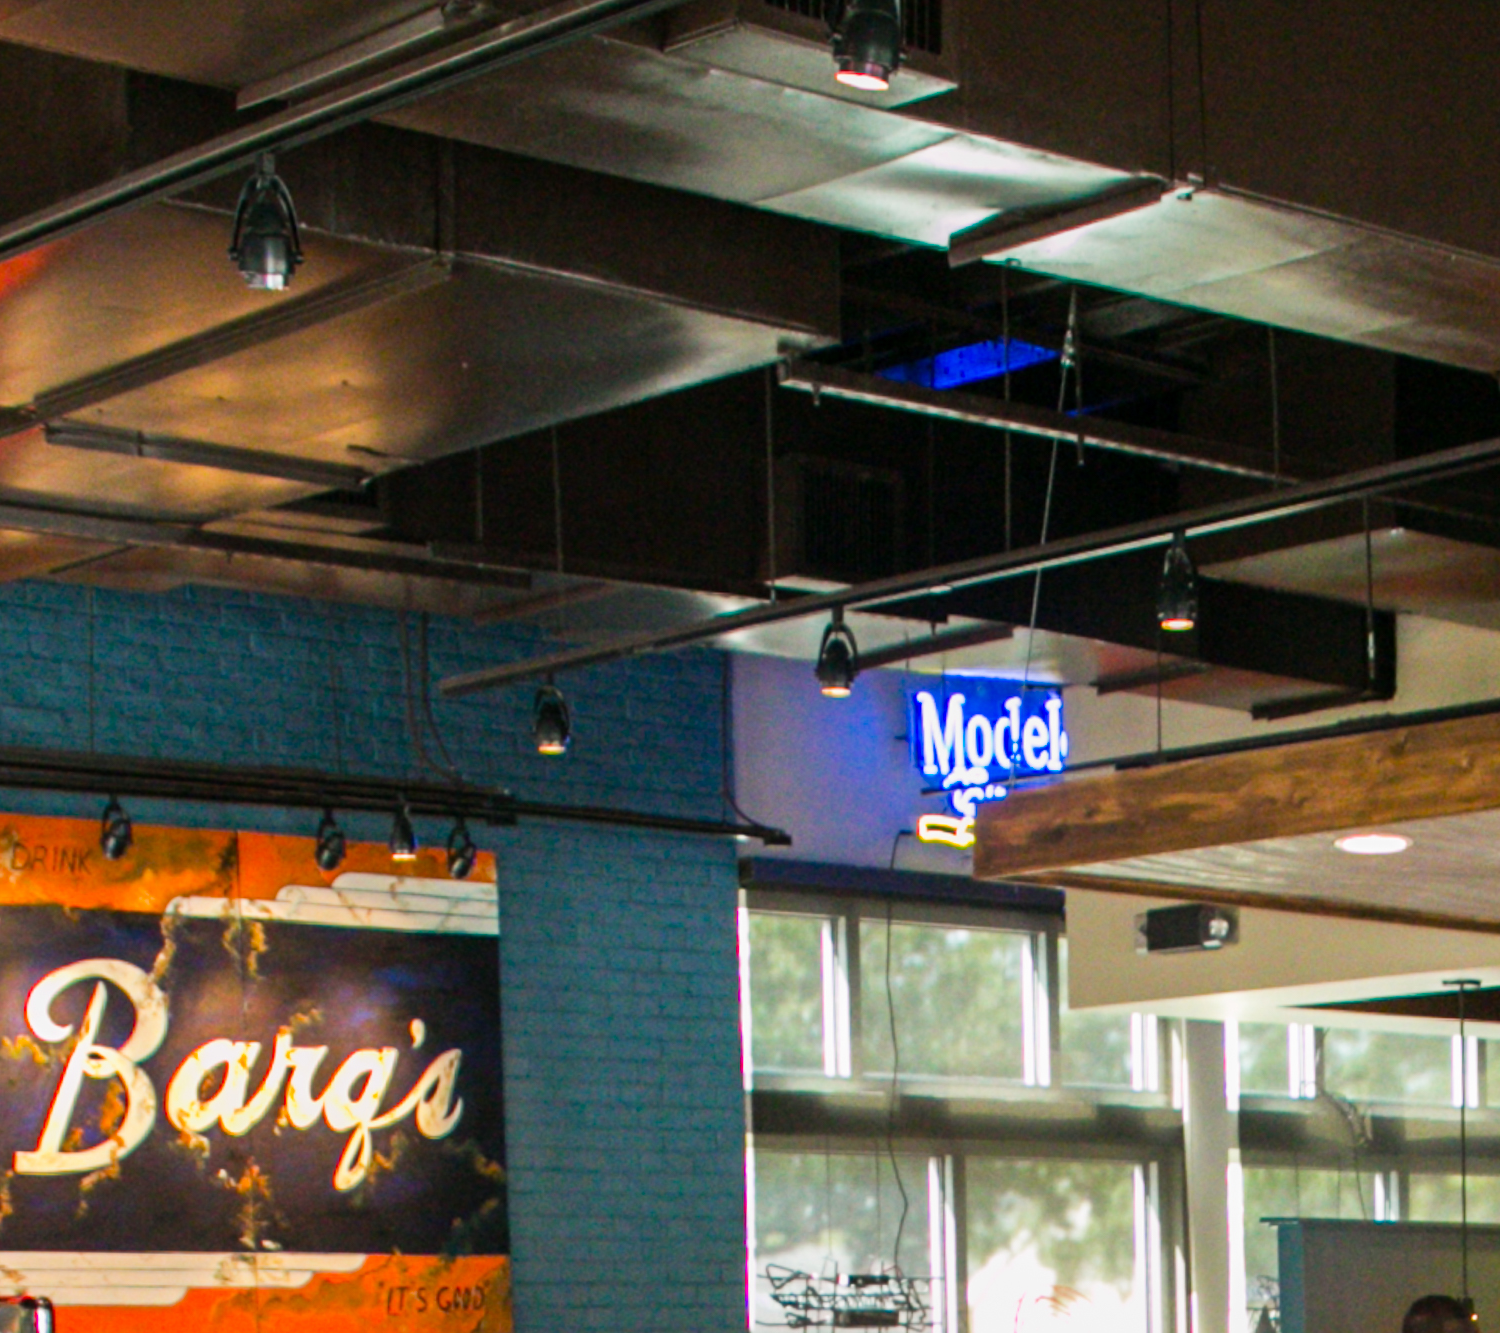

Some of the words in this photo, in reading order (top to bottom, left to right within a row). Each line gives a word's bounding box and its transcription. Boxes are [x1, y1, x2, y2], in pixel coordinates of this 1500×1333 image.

[916, 690, 1069, 776] Model
[10, 840, 93, 876] DRINK
[12, 956, 464, 1192] Barq's
